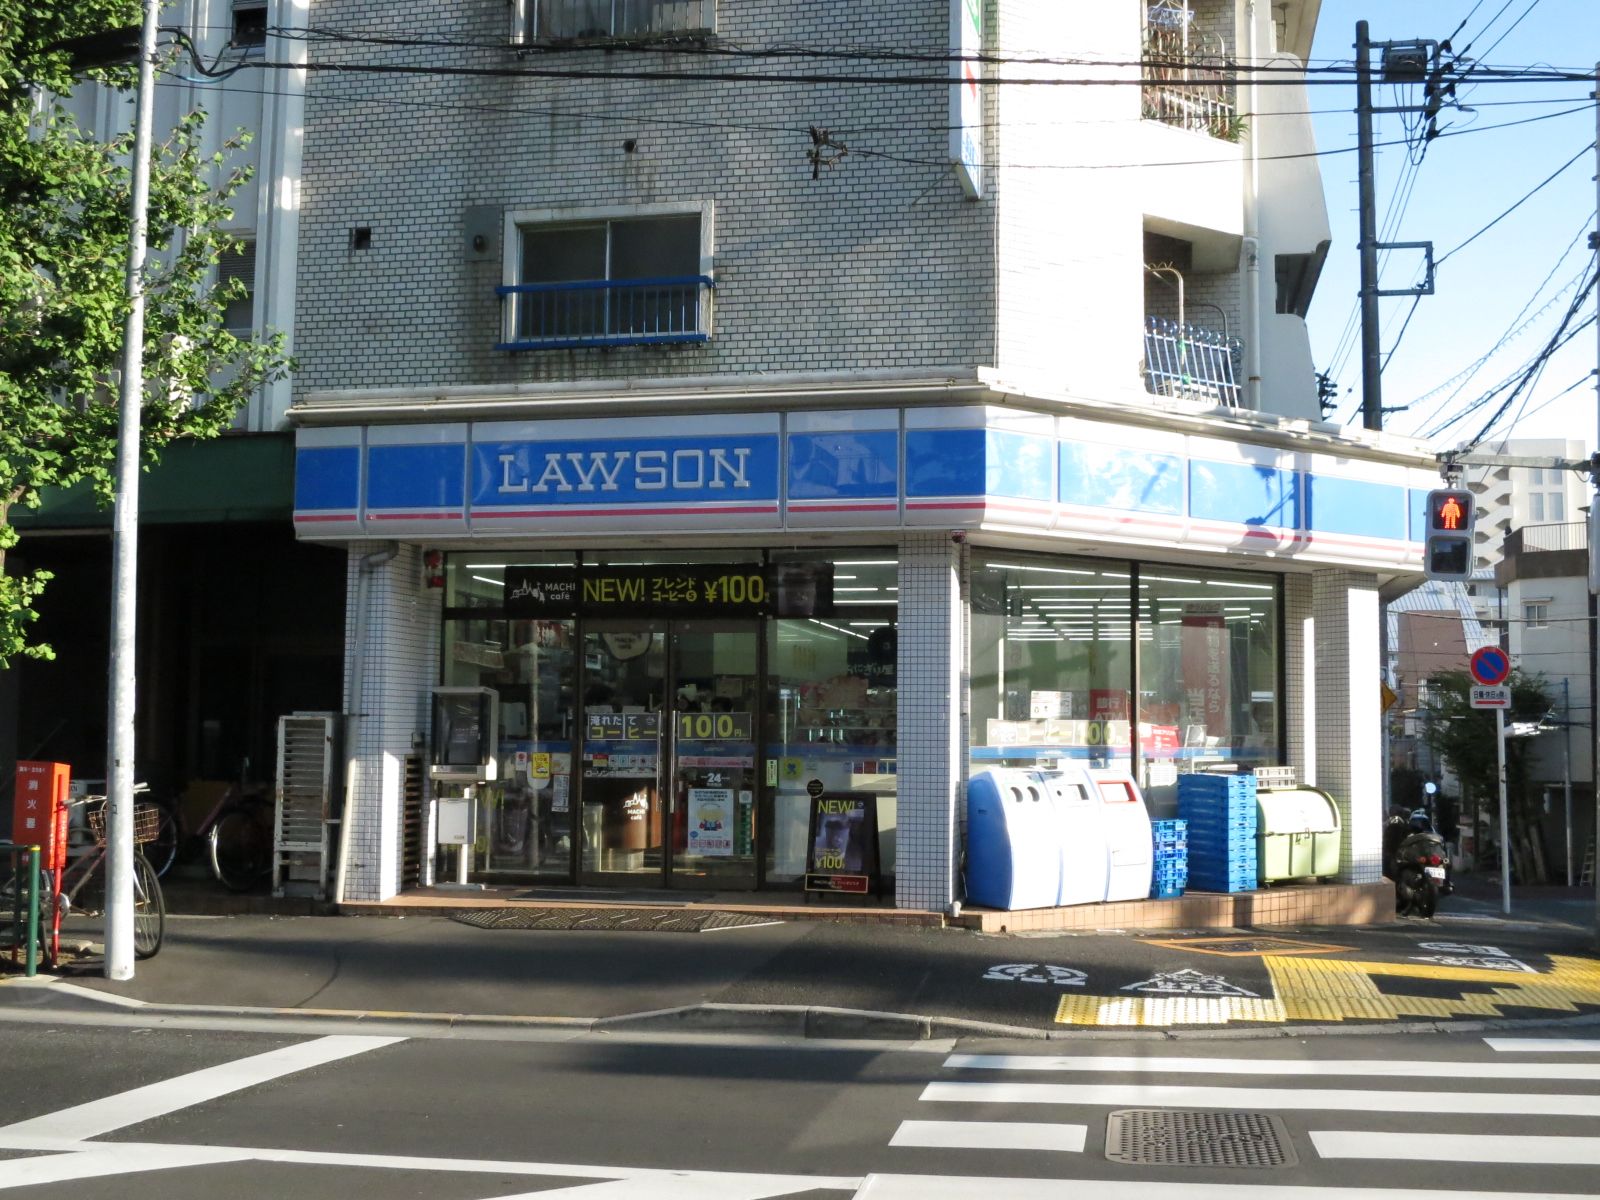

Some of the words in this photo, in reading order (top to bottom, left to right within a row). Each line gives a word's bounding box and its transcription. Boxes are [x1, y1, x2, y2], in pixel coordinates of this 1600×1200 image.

[498, 448, 751, 493] LAWSON
[545, 582, 576, 591] MACHI
[583, 578, 645, 602] NEW!
[652, 577, 696, 589] ブレンド
[704, 575, 764, 603] ¥100
[591, 726, 658, 739] コーヒー
[706, 772, 722, 783] 24
[818, 799, 856, 814] NEW!
